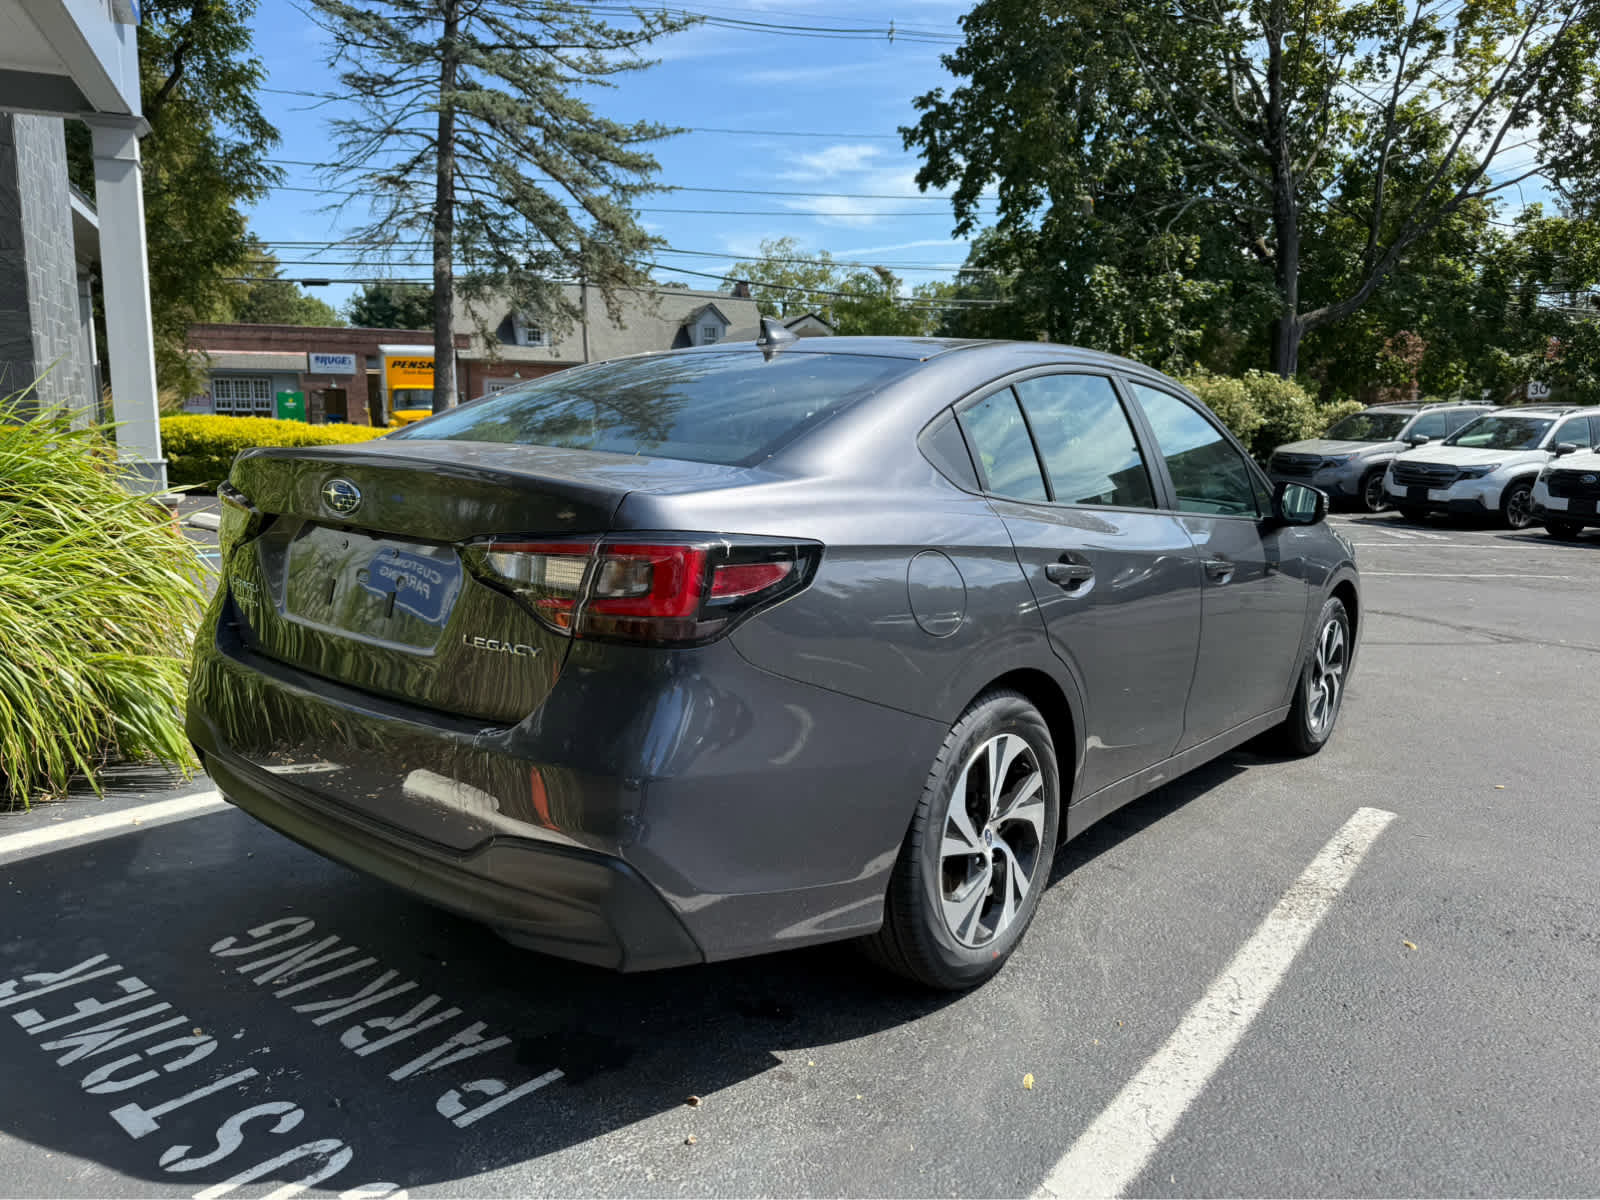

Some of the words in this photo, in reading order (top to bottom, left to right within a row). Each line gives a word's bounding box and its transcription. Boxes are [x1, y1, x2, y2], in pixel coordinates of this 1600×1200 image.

[392, 360, 435, 369] PENSK
[1531, 383, 1548, 395] 30
[463, 634, 544, 657] LEGACY
[210, 917, 565, 1129] PARKING
[0, 953, 408, 1200] USTOMER
